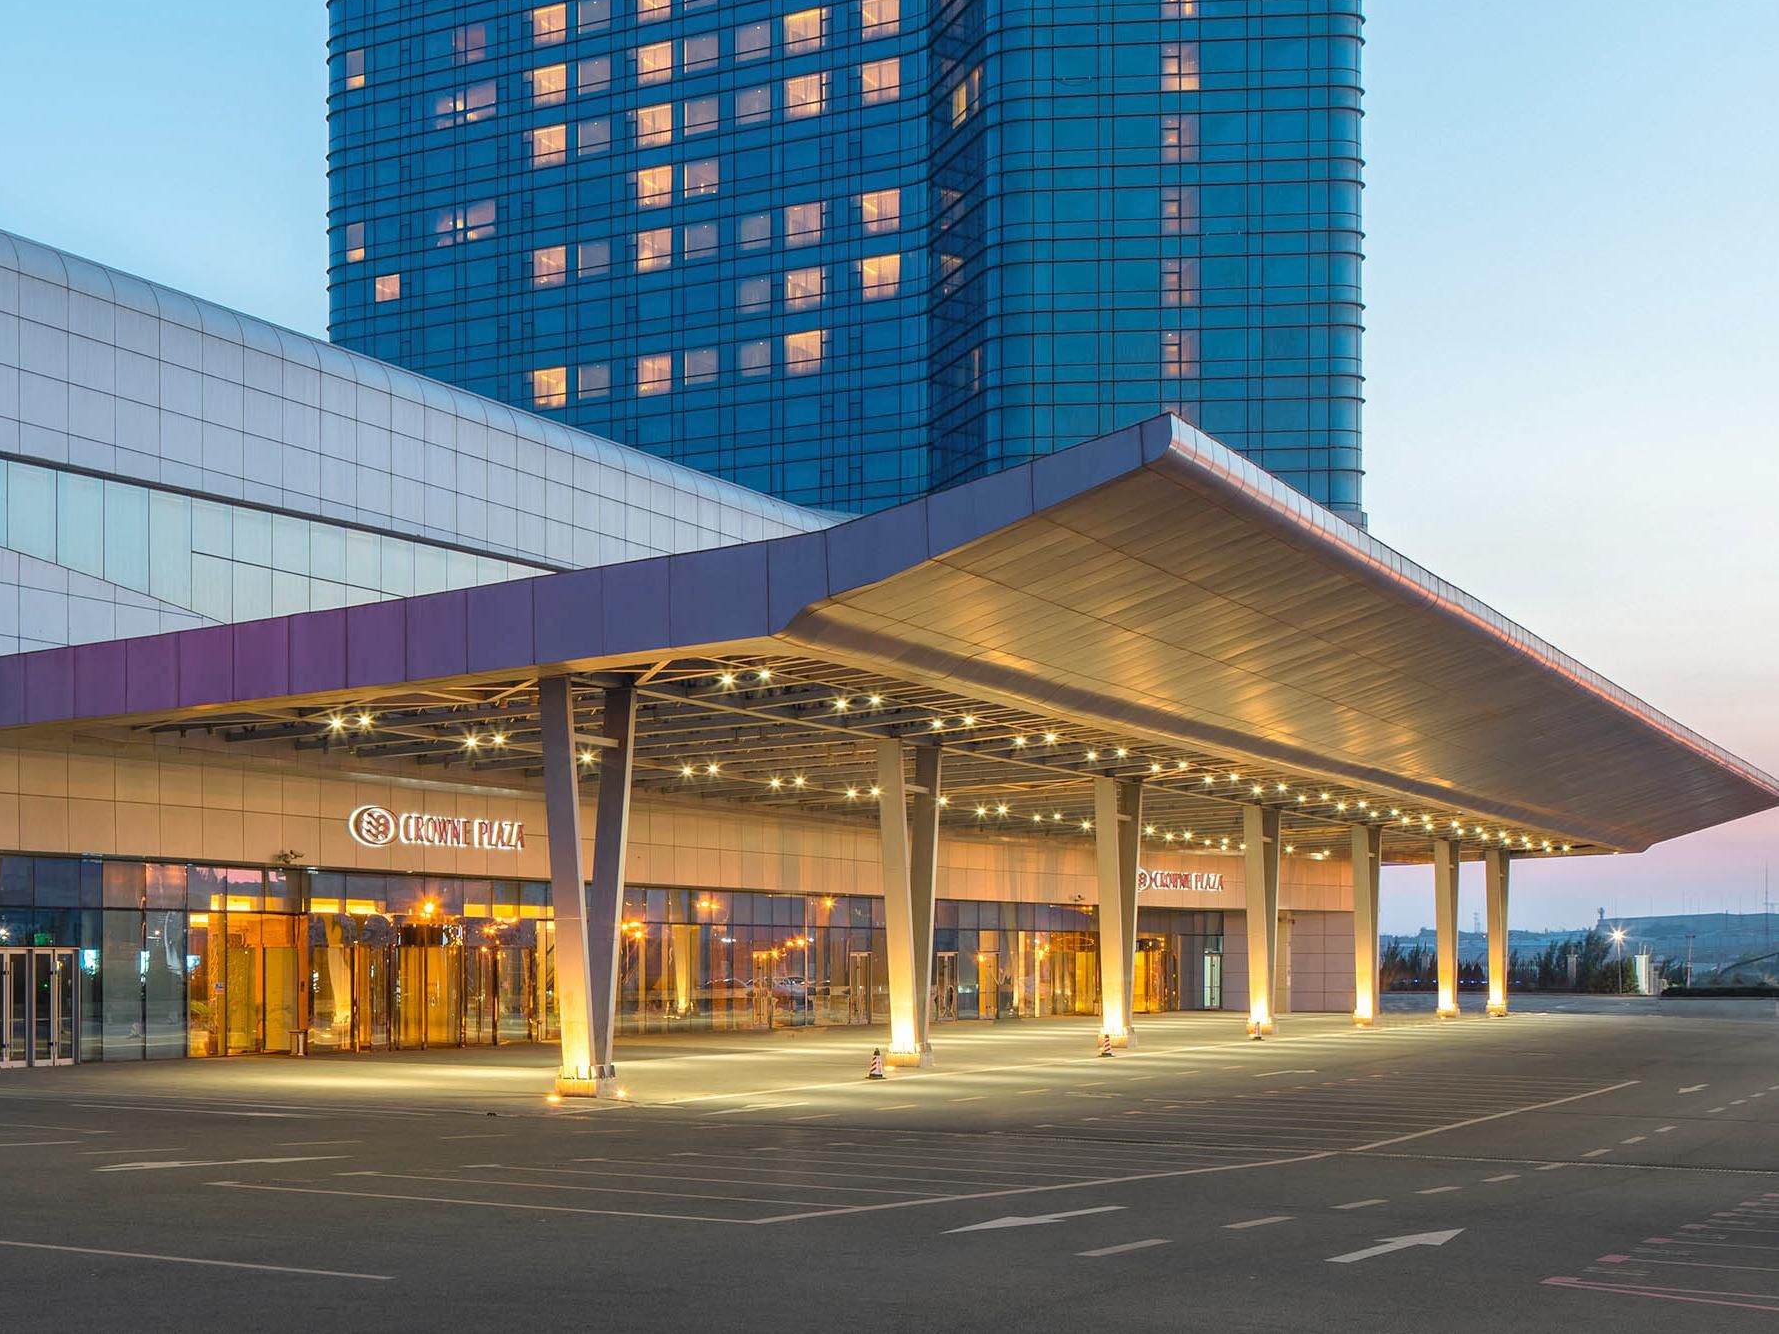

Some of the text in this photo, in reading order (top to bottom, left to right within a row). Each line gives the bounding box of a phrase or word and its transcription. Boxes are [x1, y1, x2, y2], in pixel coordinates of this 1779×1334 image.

[399, 813, 526, 850] CROWNE PLAZA
[1190, 872, 1224, 892] PLAZA
